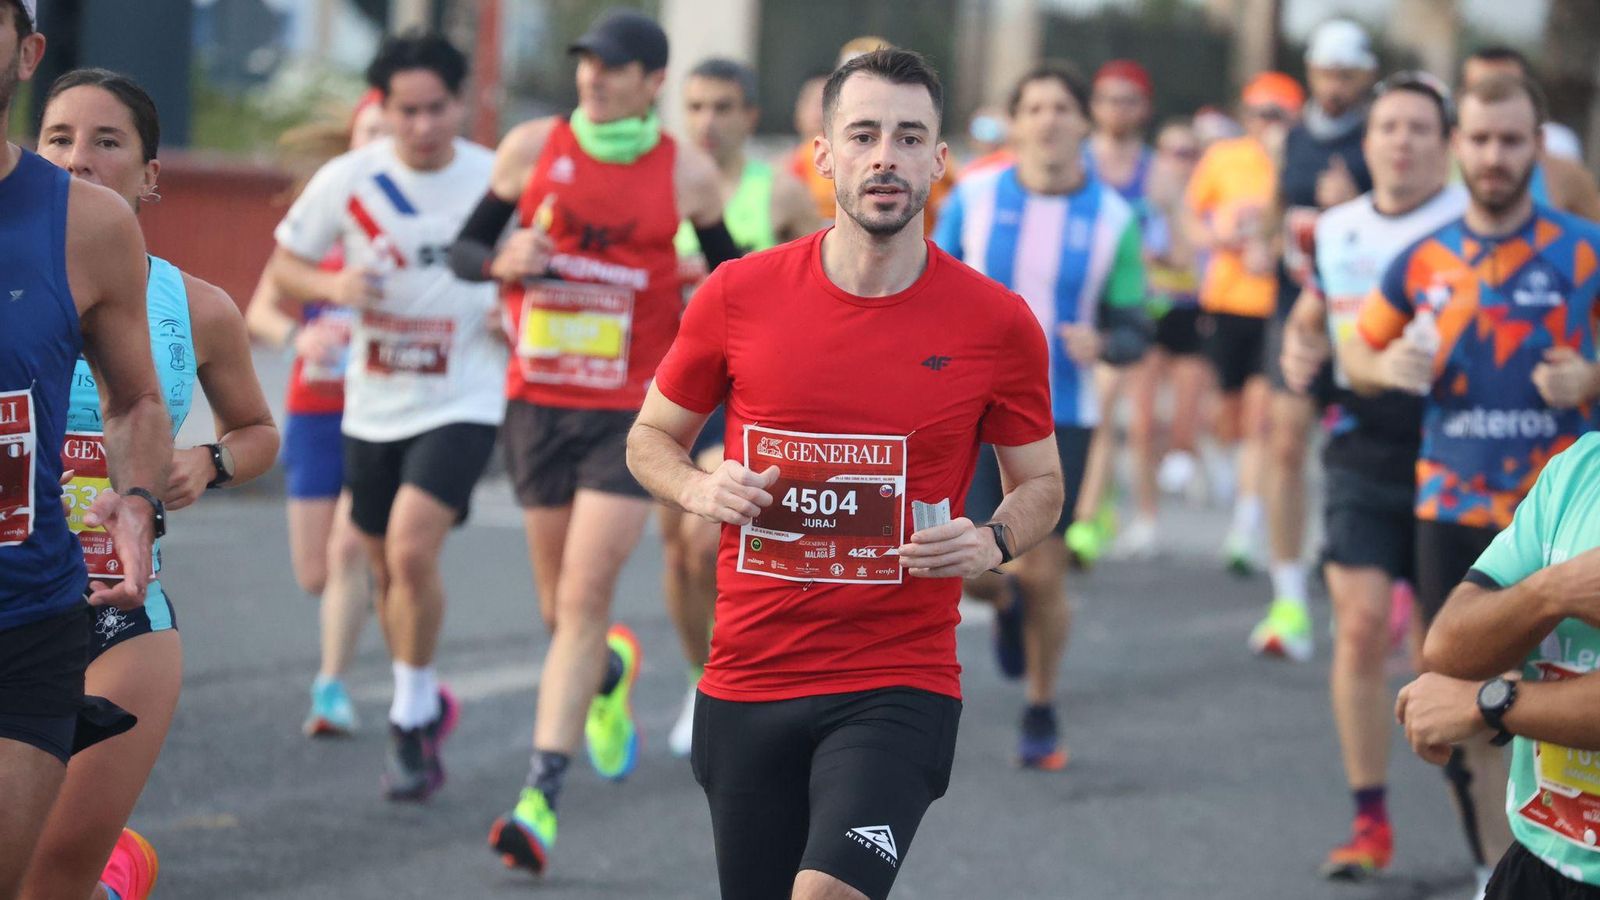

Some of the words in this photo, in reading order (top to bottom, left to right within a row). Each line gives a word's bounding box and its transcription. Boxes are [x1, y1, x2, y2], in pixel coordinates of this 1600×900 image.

[920, 355, 952, 371] 4F
[784, 441, 893, 465] GENERALI
[781, 487, 858, 516] 4504
[801, 518, 837, 529] JURAJ
[847, 548, 878, 558] 42K
[845, 831, 872, 849] NIKE
[875, 847, 897, 868] TRAIL
